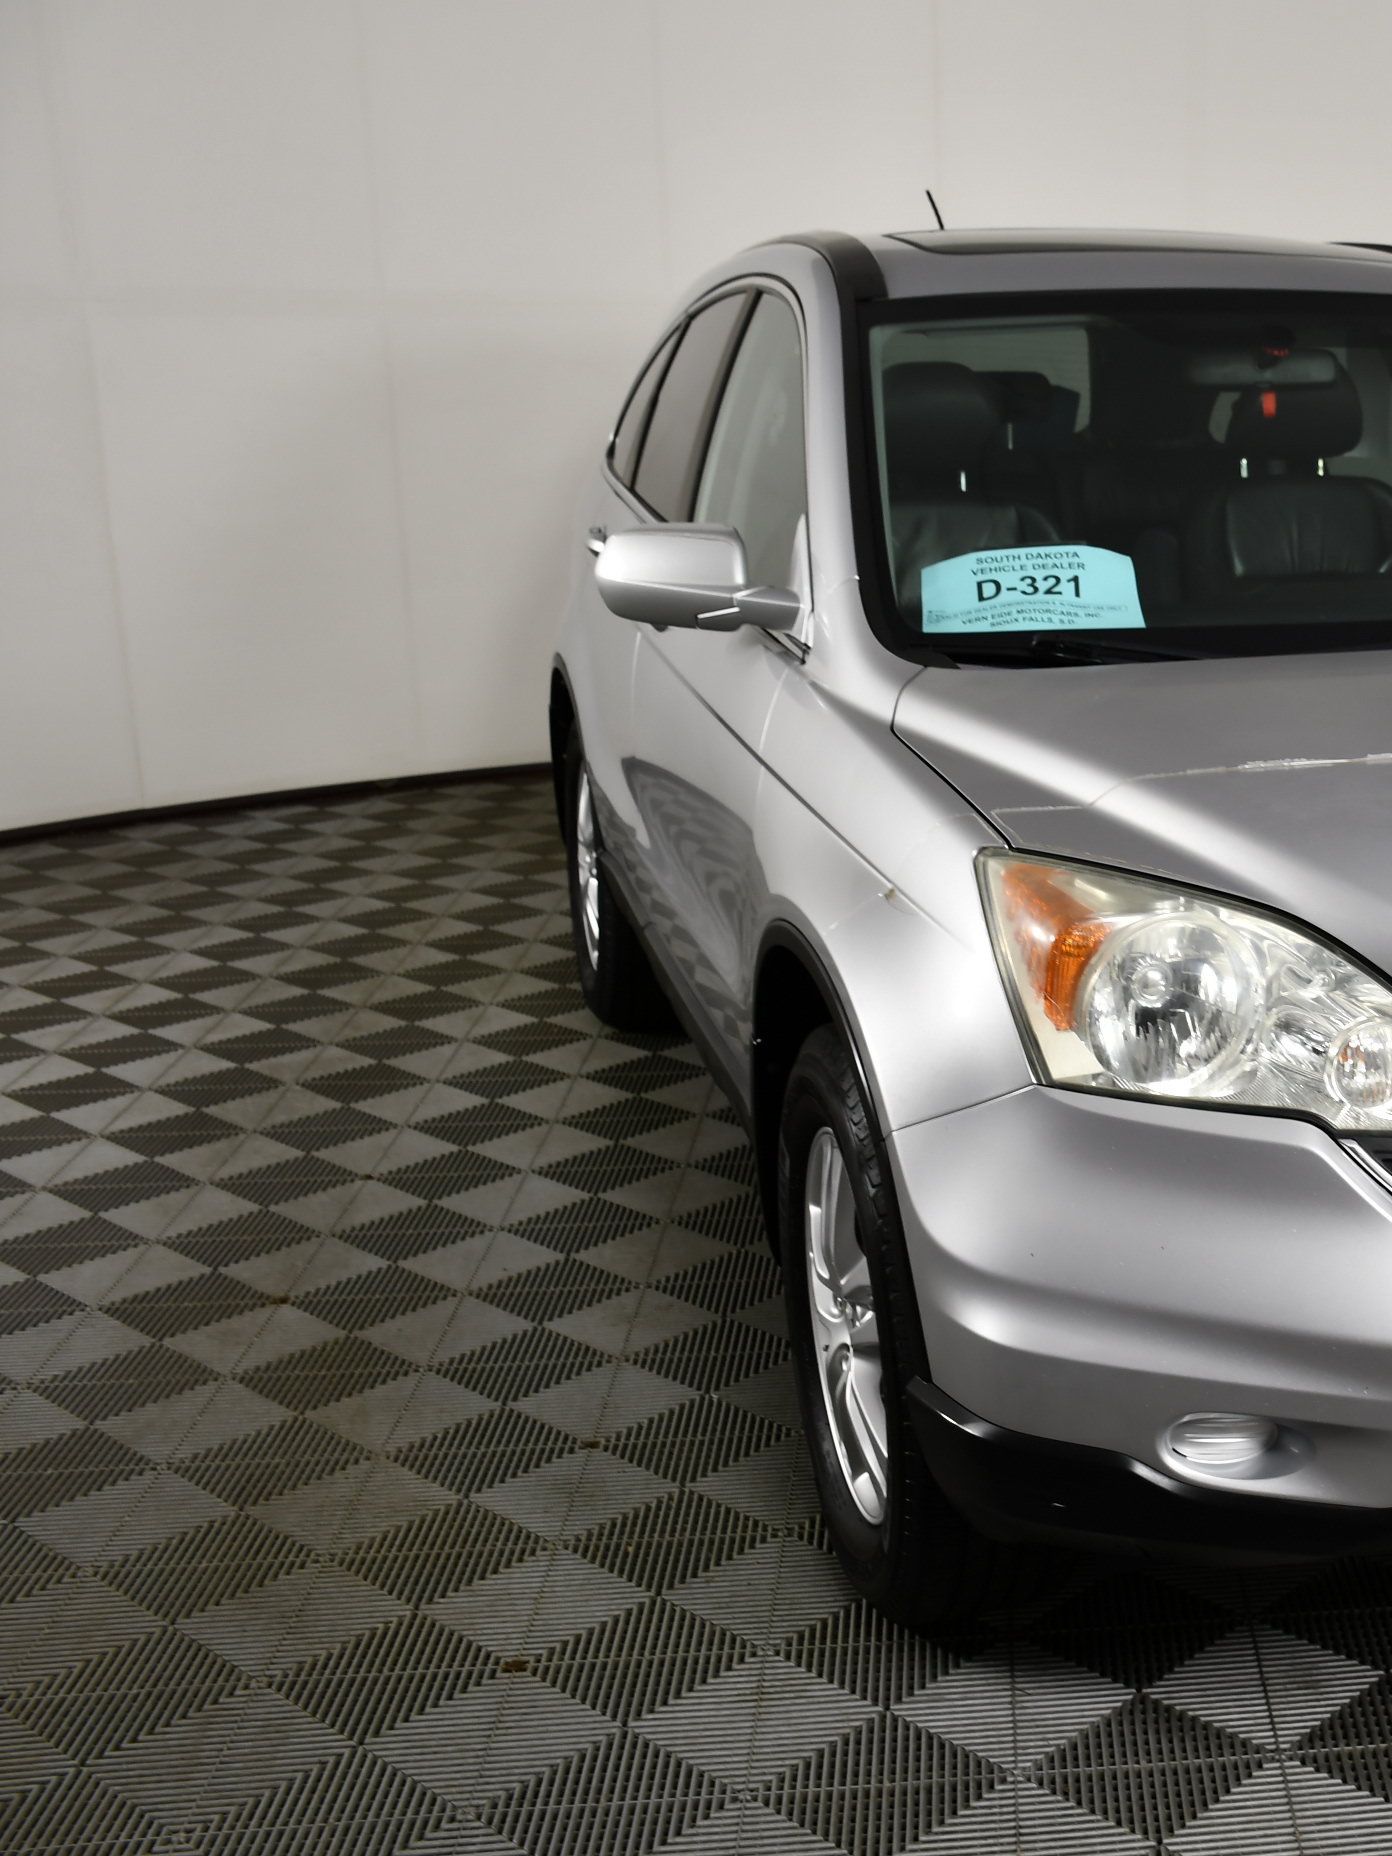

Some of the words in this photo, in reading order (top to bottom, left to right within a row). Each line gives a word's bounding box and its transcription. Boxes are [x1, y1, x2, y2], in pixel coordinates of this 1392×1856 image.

[975, 554, 1021, 565] SOUTH
[1025, 551, 1080, 561] DAKOTA
[971, 563, 1028, 576] VEHICLE
[1032, 562, 1085, 570] DEALER
[976, 575, 1080, 602] D-321
[961, 614, 988, 625] VERN
